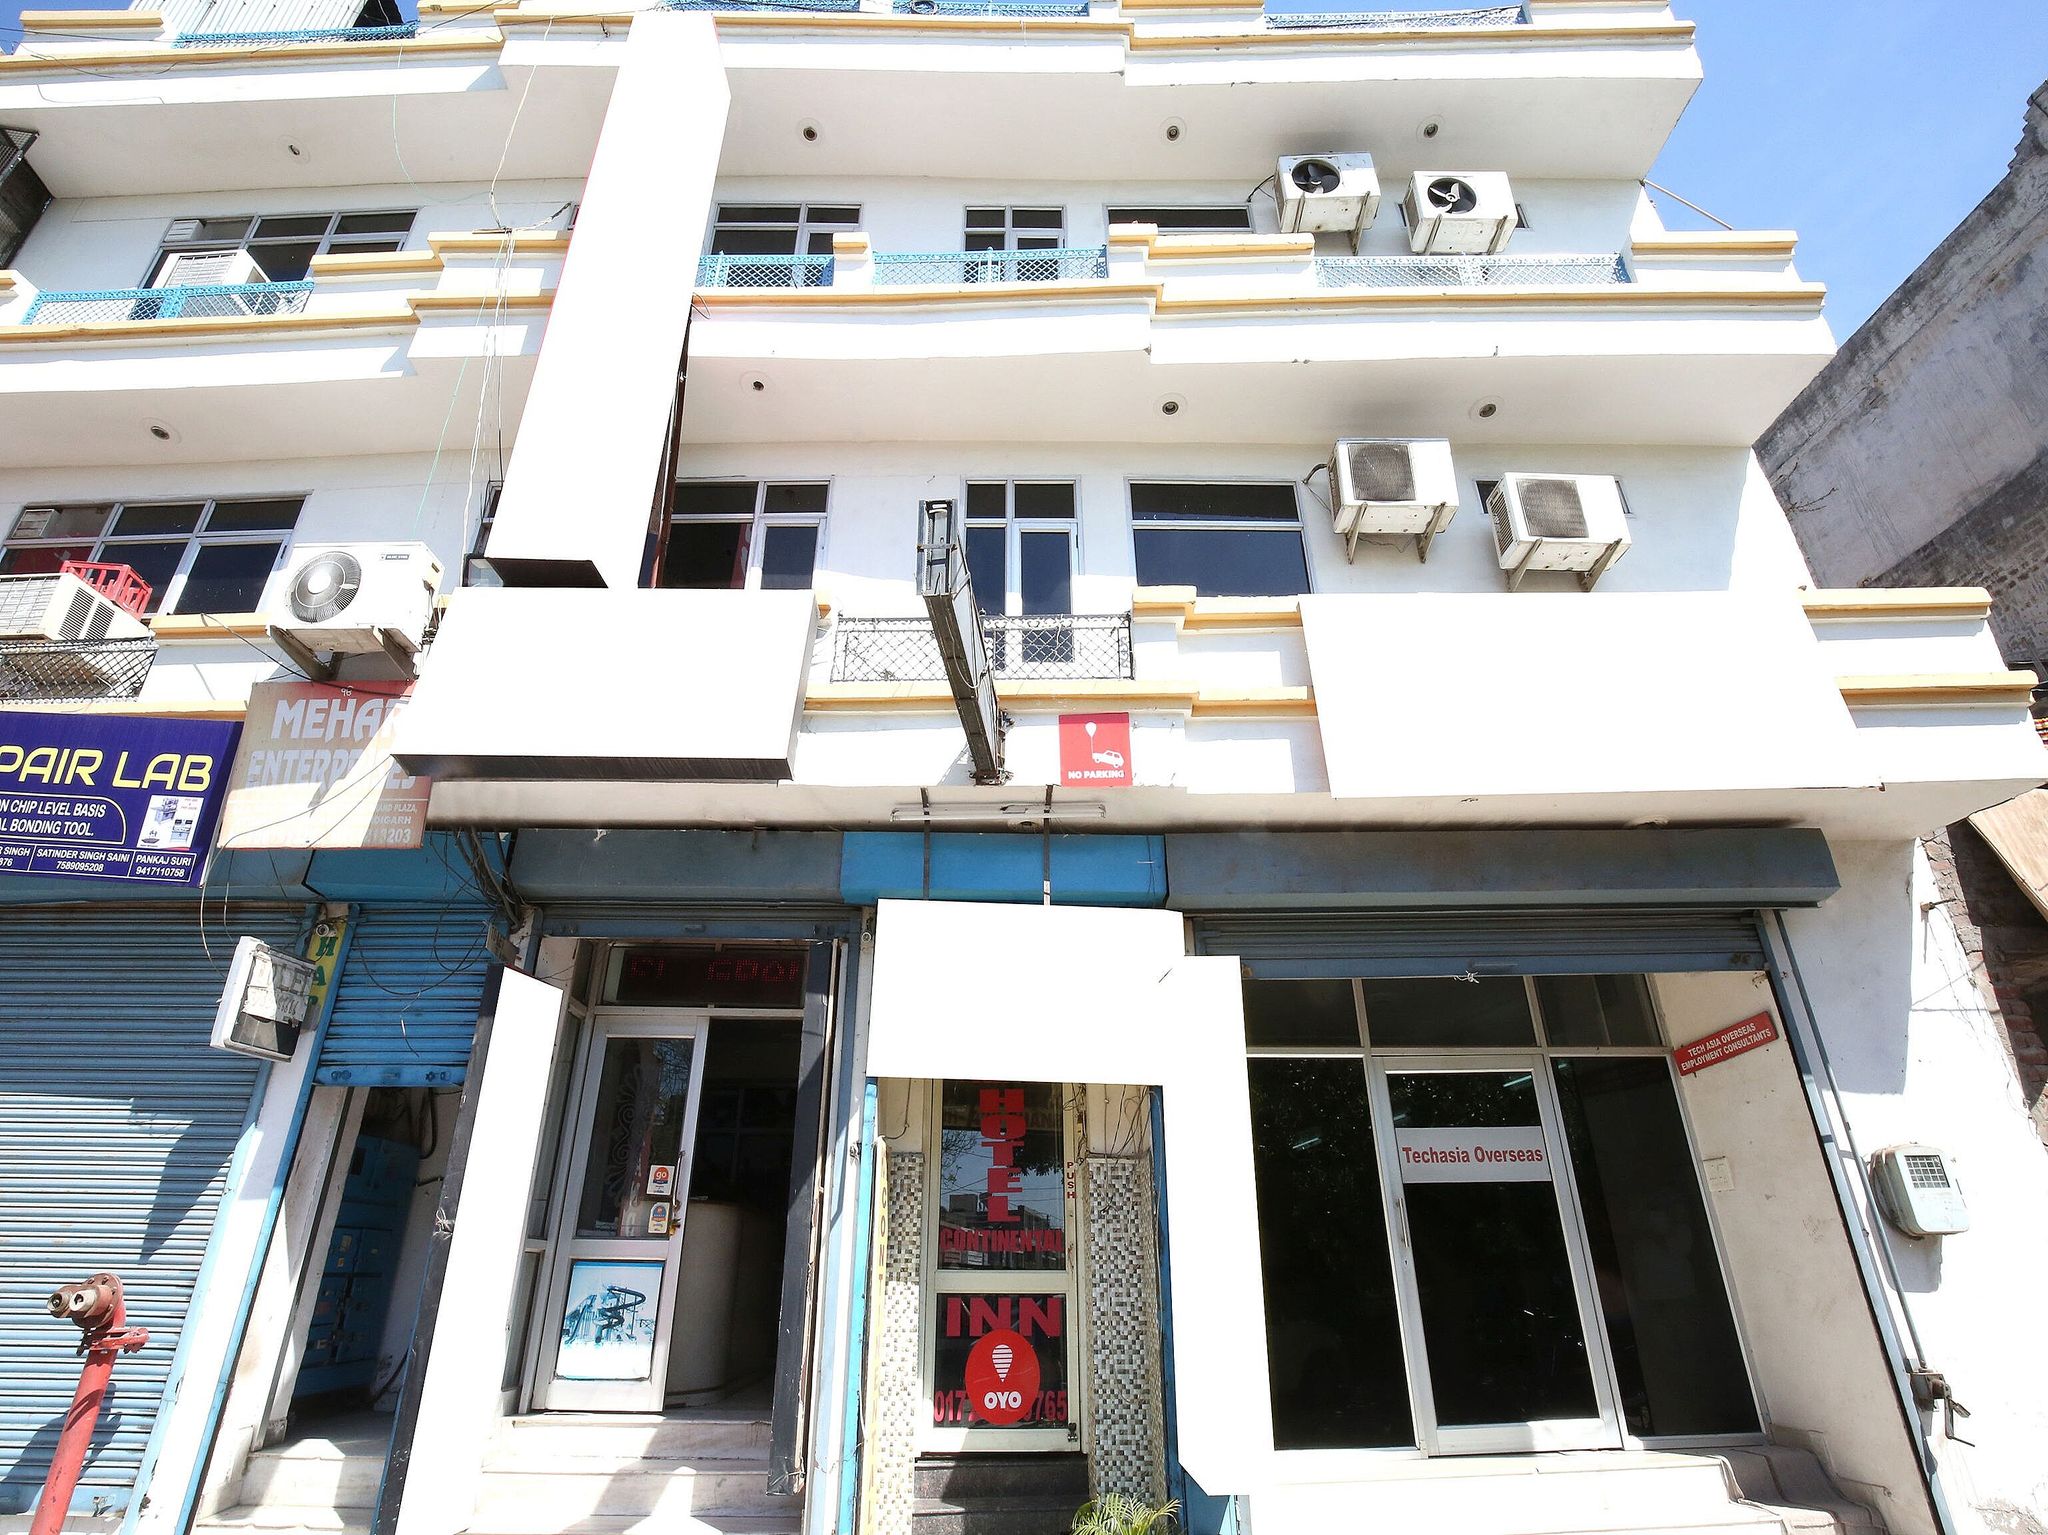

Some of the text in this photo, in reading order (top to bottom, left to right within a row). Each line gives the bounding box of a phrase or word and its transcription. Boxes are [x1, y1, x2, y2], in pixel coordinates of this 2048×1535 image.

[112, 751, 213, 792] LAB
[1067, 769, 1125, 779] NO PARKING
[10, 800, 38, 814] CHIP
[37, 801, 71, 816] LEVEL
[73, 803, 107, 818] BASIS
[9, 819, 61, 834] BONDING
[63, 821, 94, 836] TOOL.
[4, 847, 31, 857] SINGH
[36, 849, 130, 863] SATINDER SINGH SAINI
[136, 855, 191, 867] PANKAJ SURI
[1681, 1028, 1772, 1071] EMPLOYMENT CONSULTANTS
[1687, 1022, 1757, 1058] TECH ASIA OVERSEAS
[979, 1088, 1027, 1222] HOTEL
[1402, 1146, 1543, 1163] Techasia Overseas
[1066, 1161, 1076, 1199] PUSH
[940, 1227, 1064, 1253] CONTINENTAL
[946, 1297, 1061, 1337] INN
[984, 1391, 1022, 1410] OYO
